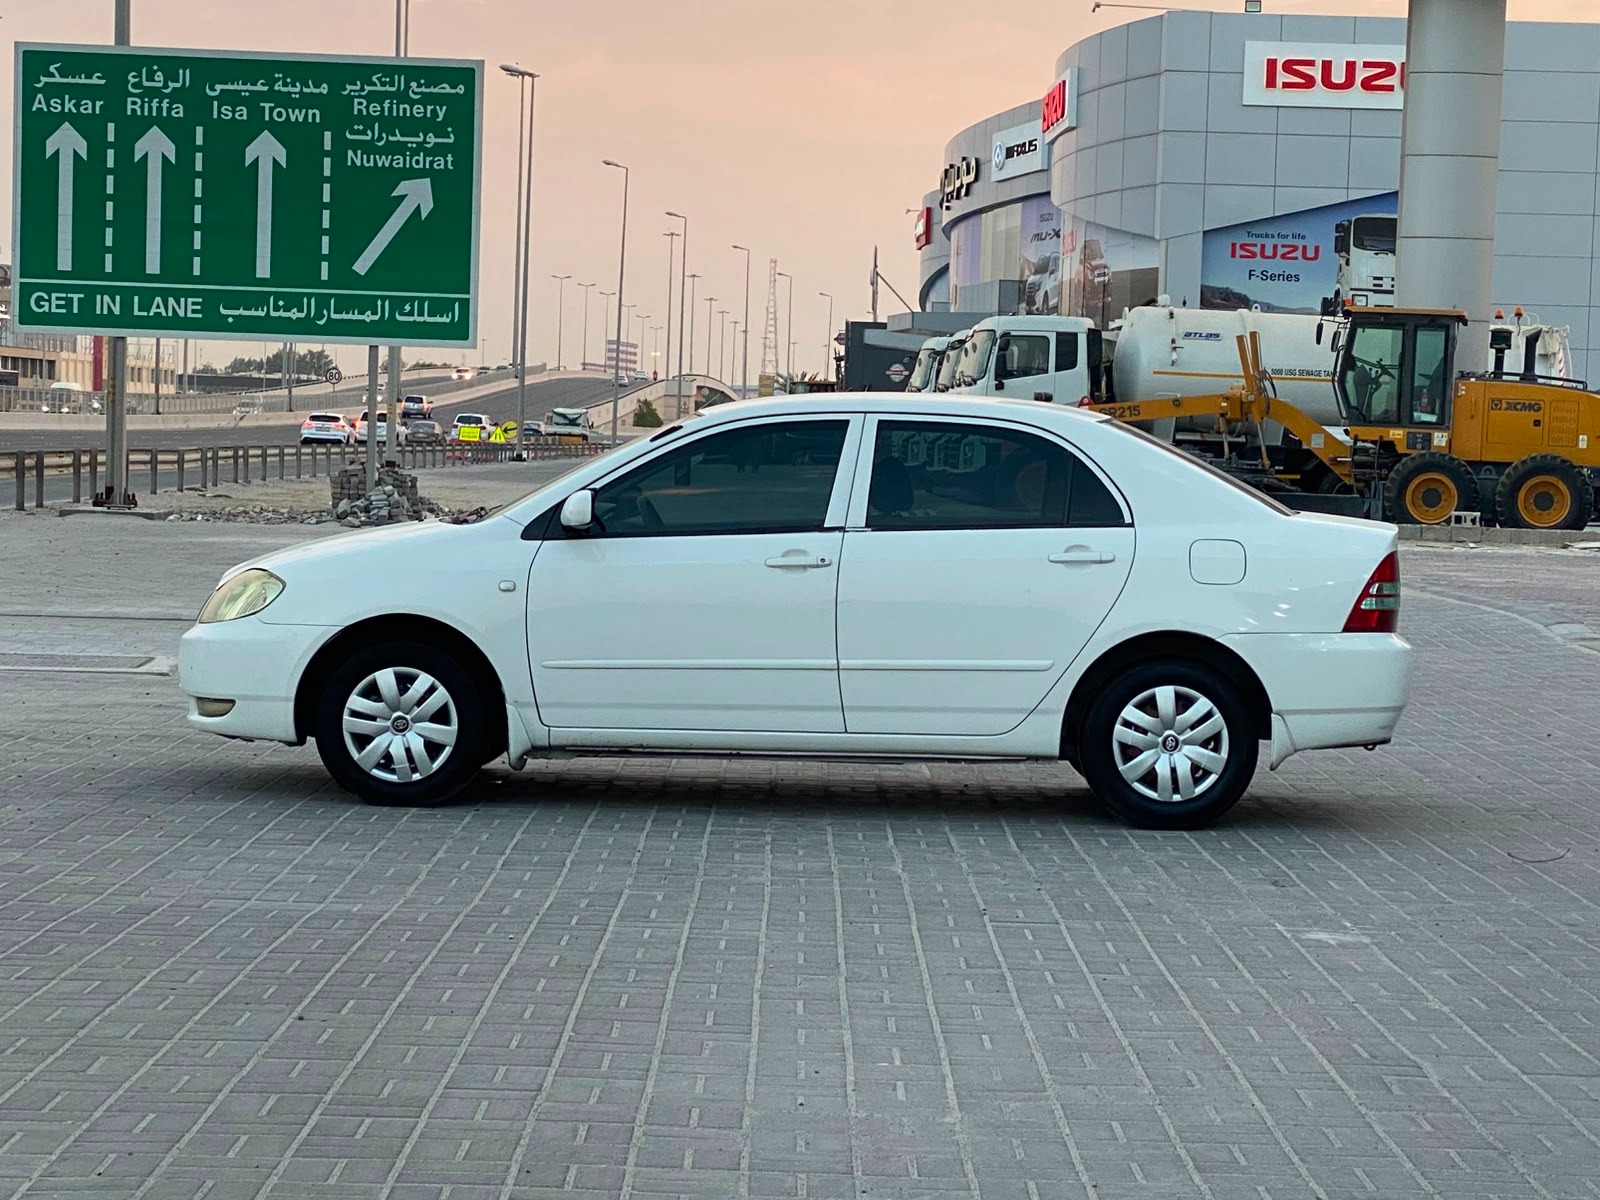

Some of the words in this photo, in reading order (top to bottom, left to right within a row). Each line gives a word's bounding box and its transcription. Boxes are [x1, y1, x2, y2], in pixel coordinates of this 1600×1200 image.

[34, 63, 106, 88] عسكر
[128, 66, 189, 93] الرفاع
[274, 74, 329, 97] مدينة
[341, 74, 405, 96] التكرير
[1266, 58, 1406, 92] ISUZ
[206, 80, 269, 97] عيسى
[409, 80, 465, 98] مصنع
[32, 94, 104, 114] Askar
[127, 97, 184, 118] Riffa
[213, 101, 247, 120] Isa
[260, 103, 320, 123] Town
[353, 97, 447, 122] Refinery
[346, 122, 455, 147] نويدرات
[347, 149, 454, 170] Nuwaidrat
[1246, 231, 1275, 240] Trucks
[1277, 232, 1290, 240] for
[1292, 232, 1306, 241] life
[1230, 242, 1321, 262] ISUZU
[1248, 269, 1300, 282] F-Series
[30, 291, 85, 314] GET
[95, 294, 121, 315] IN
[134, 296, 203, 318] LANE
[219, 296, 315, 323] المناسب
[316, 298, 389, 325] المسار
[396, 301, 459, 323] اسلك
[328, 371, 340, 381] 80
[1271, 368, 1284, 376] 5000
[1285, 368, 1297, 377] USG
[1298, 369, 1322, 378] SEWAGE
[1503, 401, 1542, 412] XCMG
